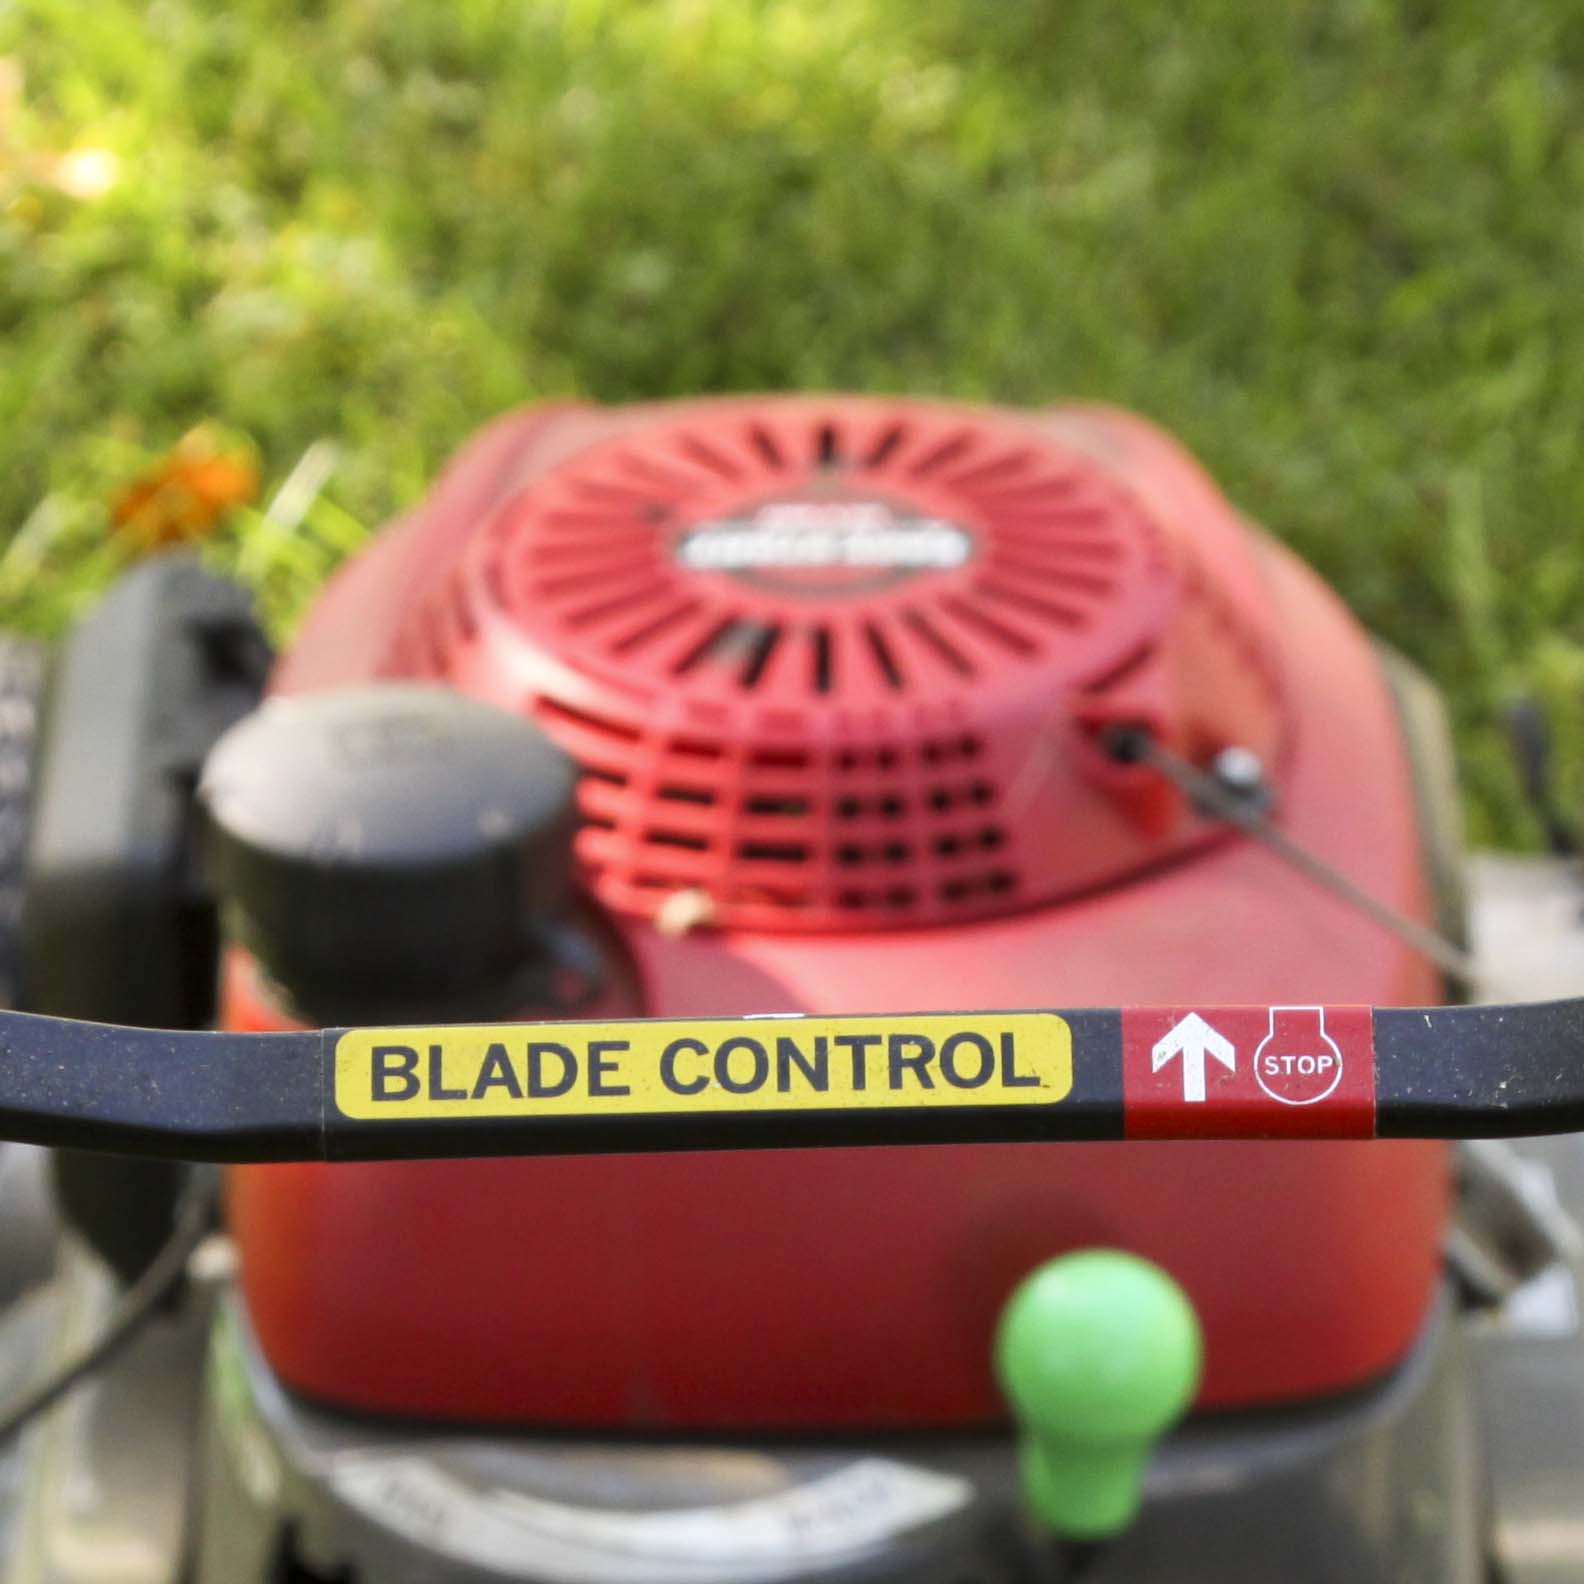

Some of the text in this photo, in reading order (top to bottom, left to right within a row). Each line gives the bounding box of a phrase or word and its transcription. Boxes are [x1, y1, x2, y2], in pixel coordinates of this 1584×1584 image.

[370, 1031, 1041, 1102] BLADE CONTROL
[1264, 1055, 1333, 1076] STOP
